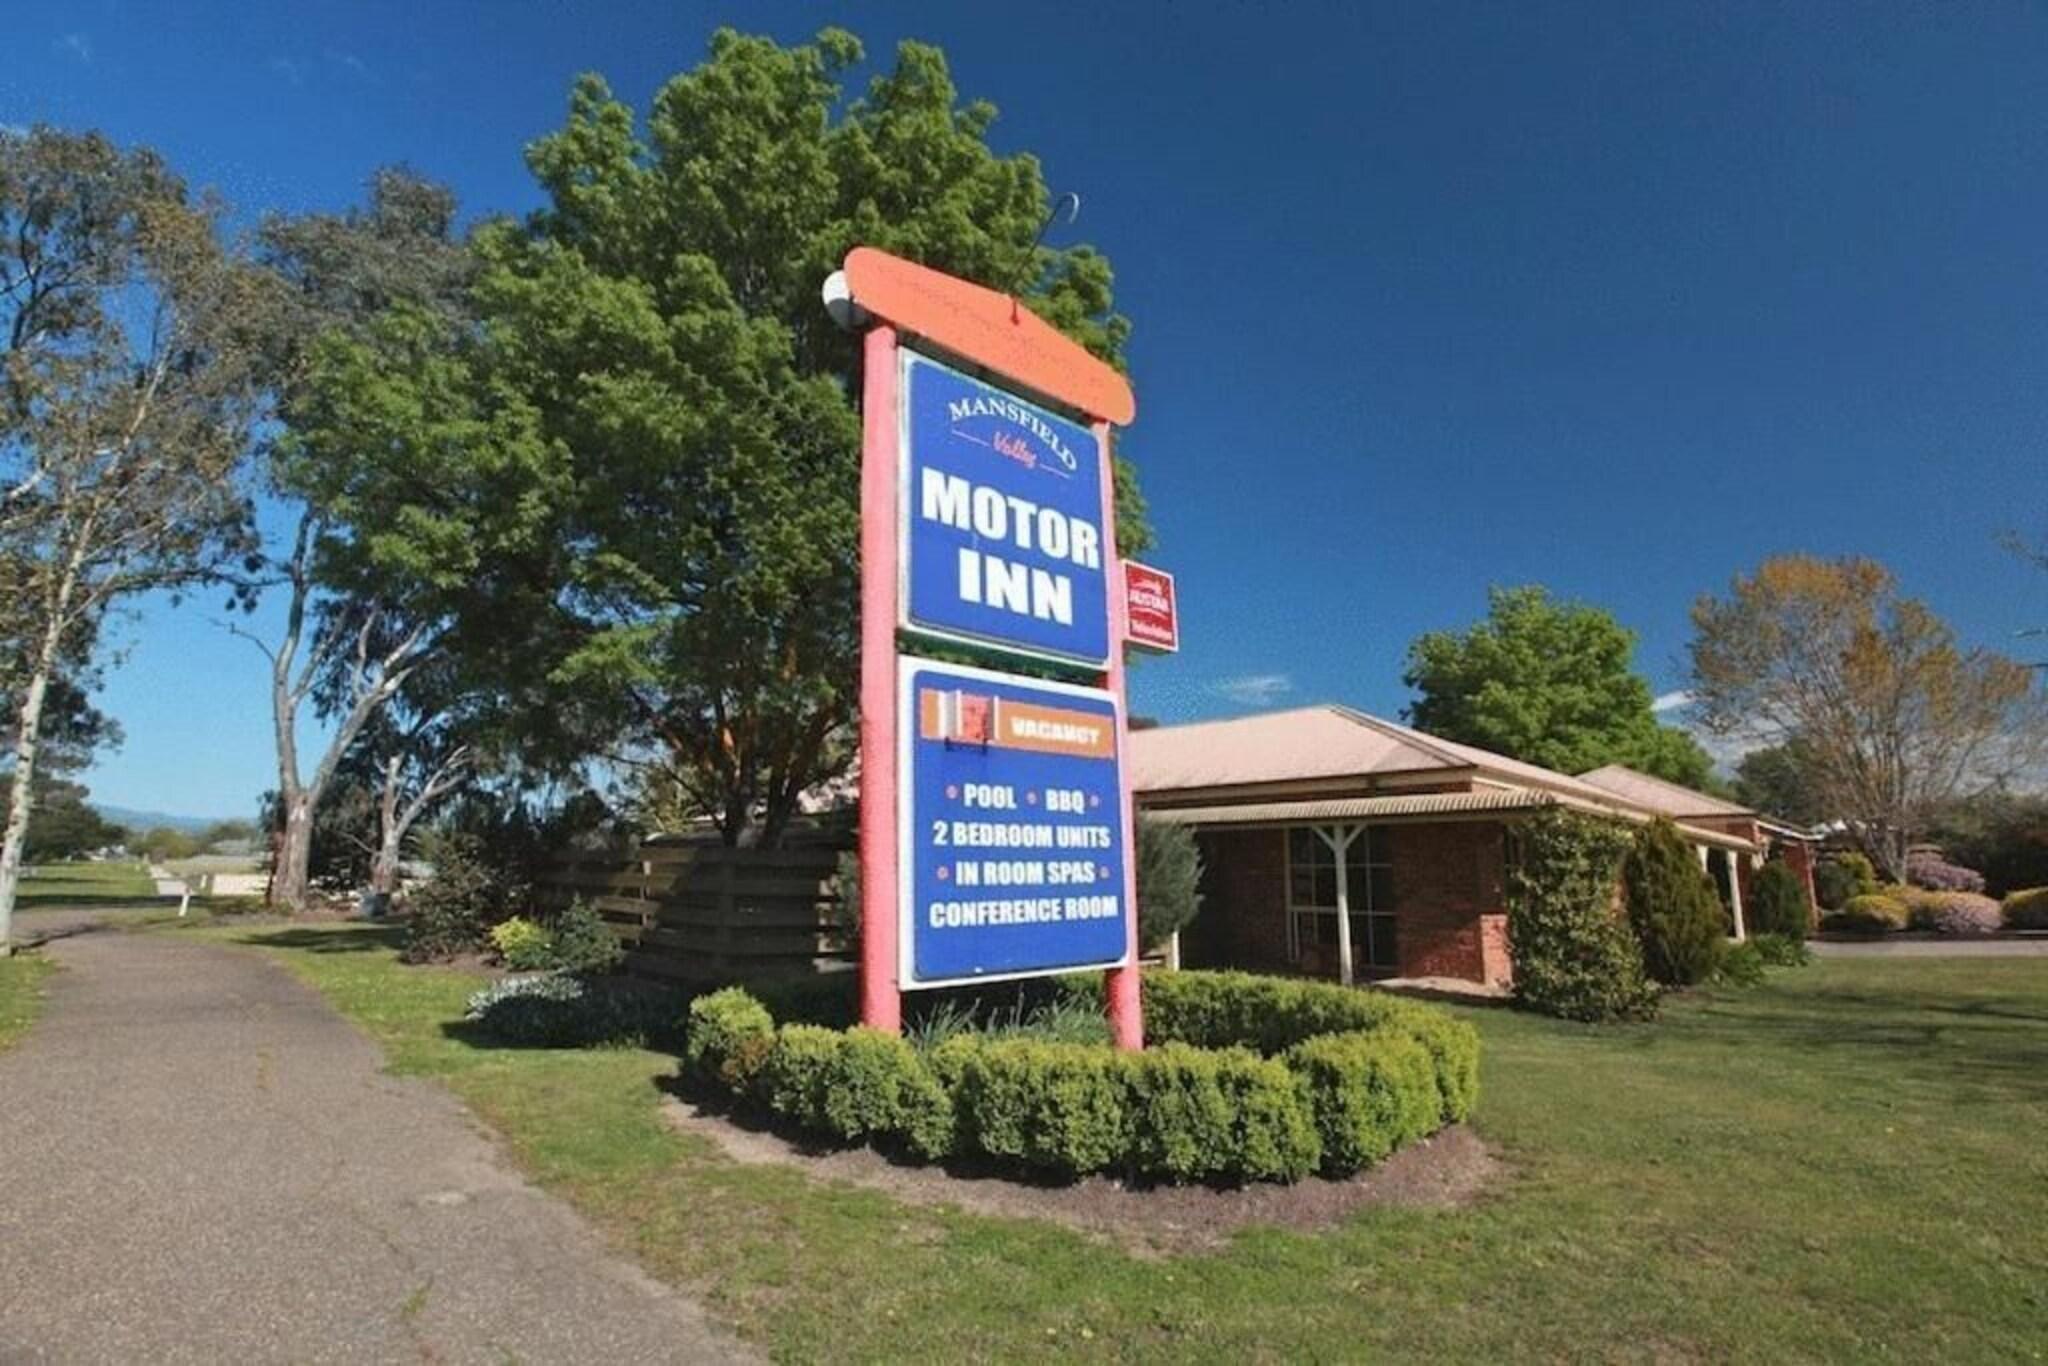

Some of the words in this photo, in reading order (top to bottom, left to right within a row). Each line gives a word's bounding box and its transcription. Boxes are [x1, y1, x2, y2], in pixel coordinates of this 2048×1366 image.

[948, 397, 1077, 471] MANSFIELD
[922, 466, 1100, 569] MOTOR
[959, 547, 1073, 626] INN
[1011, 716, 1102, 744] VACANCY
[964, 783, 1017, 810] POOL
[1045, 789, 1086, 814] BBQ
[933, 820, 948, 846] 2
[953, 822, 1053, 848] BEDROOM
[1056, 825, 1111, 849] UNITS
[956, 861, 979, 886] IN
[983, 861, 1044, 885] ROOM
[1048, 861, 1095, 885] SPAS
[929, 901, 1062, 928] CONFERENCE
[1065, 895, 1118, 919] ROOM
